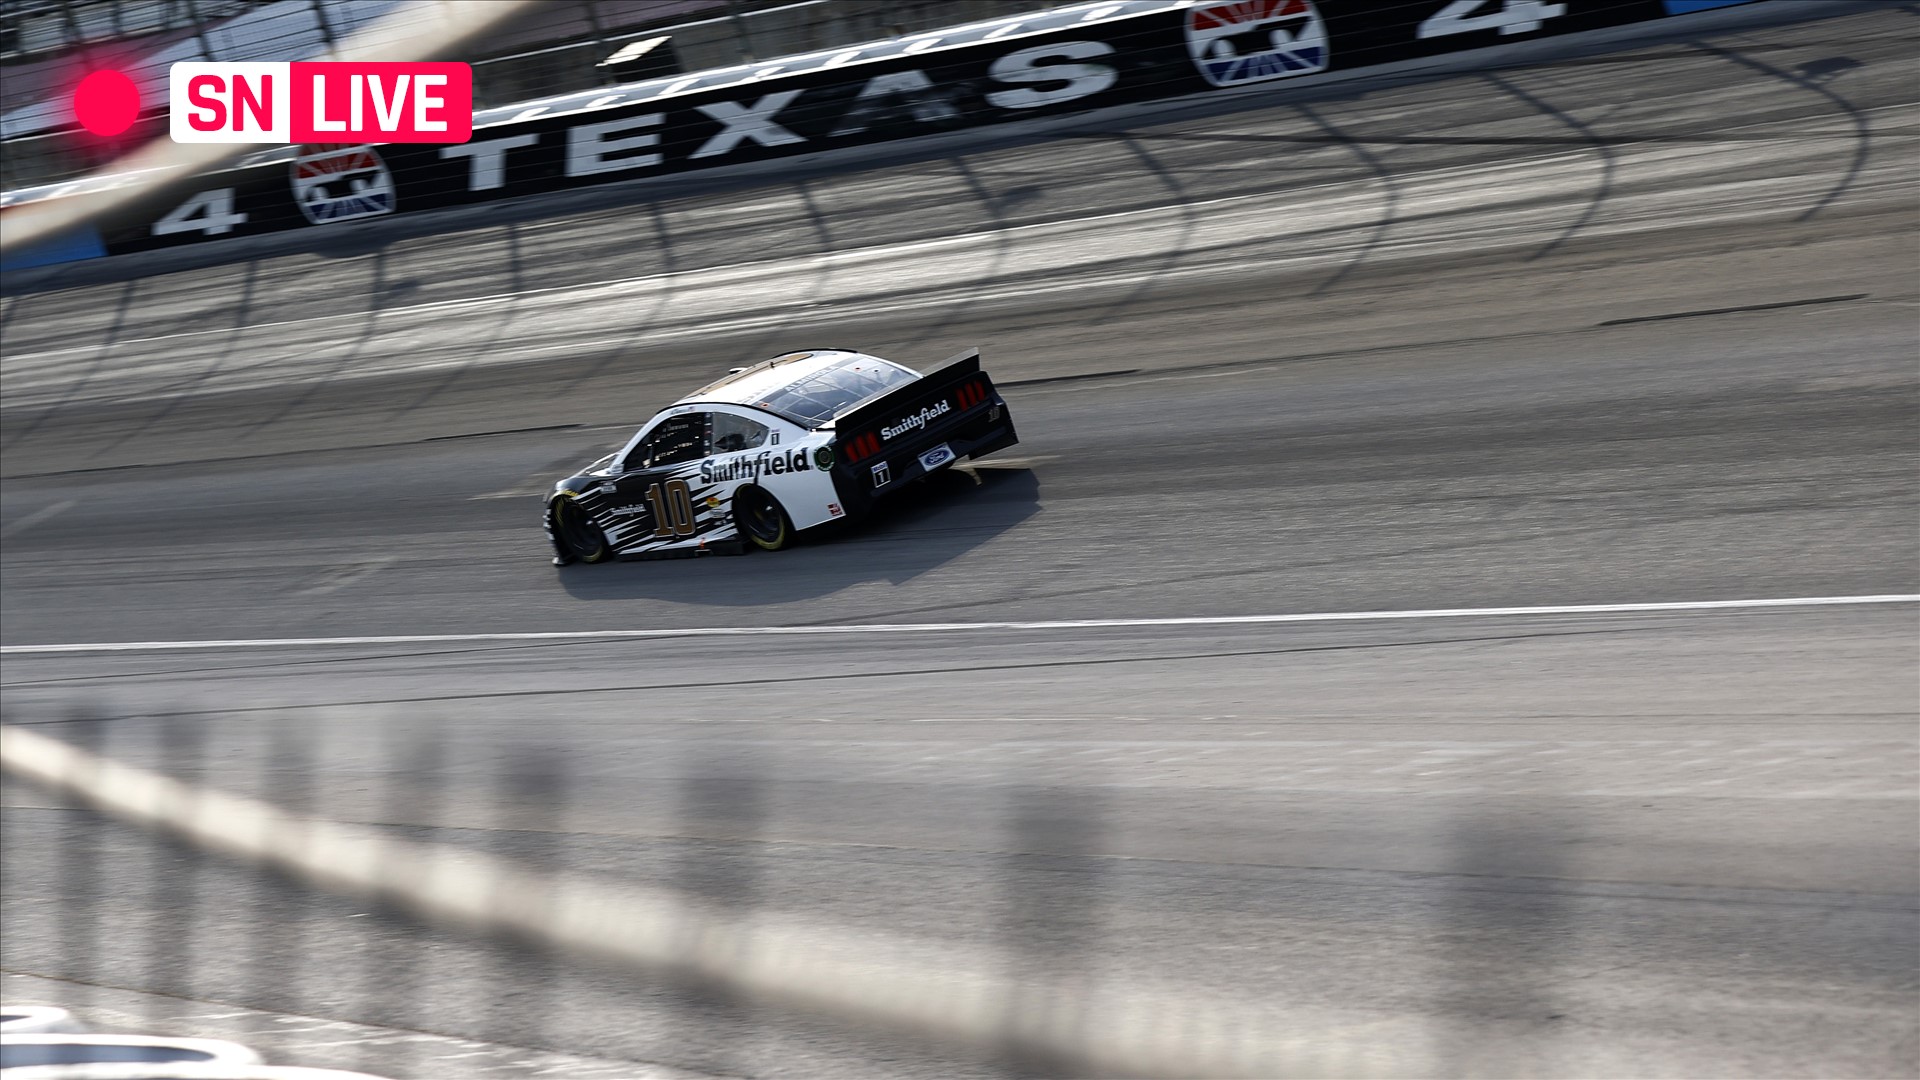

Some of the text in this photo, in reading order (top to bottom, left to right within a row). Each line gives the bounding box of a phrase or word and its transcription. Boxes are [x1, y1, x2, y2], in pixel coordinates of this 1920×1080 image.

[440, 41, 1118, 191] TEXAS
[151, 188, 248, 236] 4
[881, 400, 951, 440] Smithfield
[701, 447, 809, 485] Smithfield
[645, 479, 696, 538] 10
